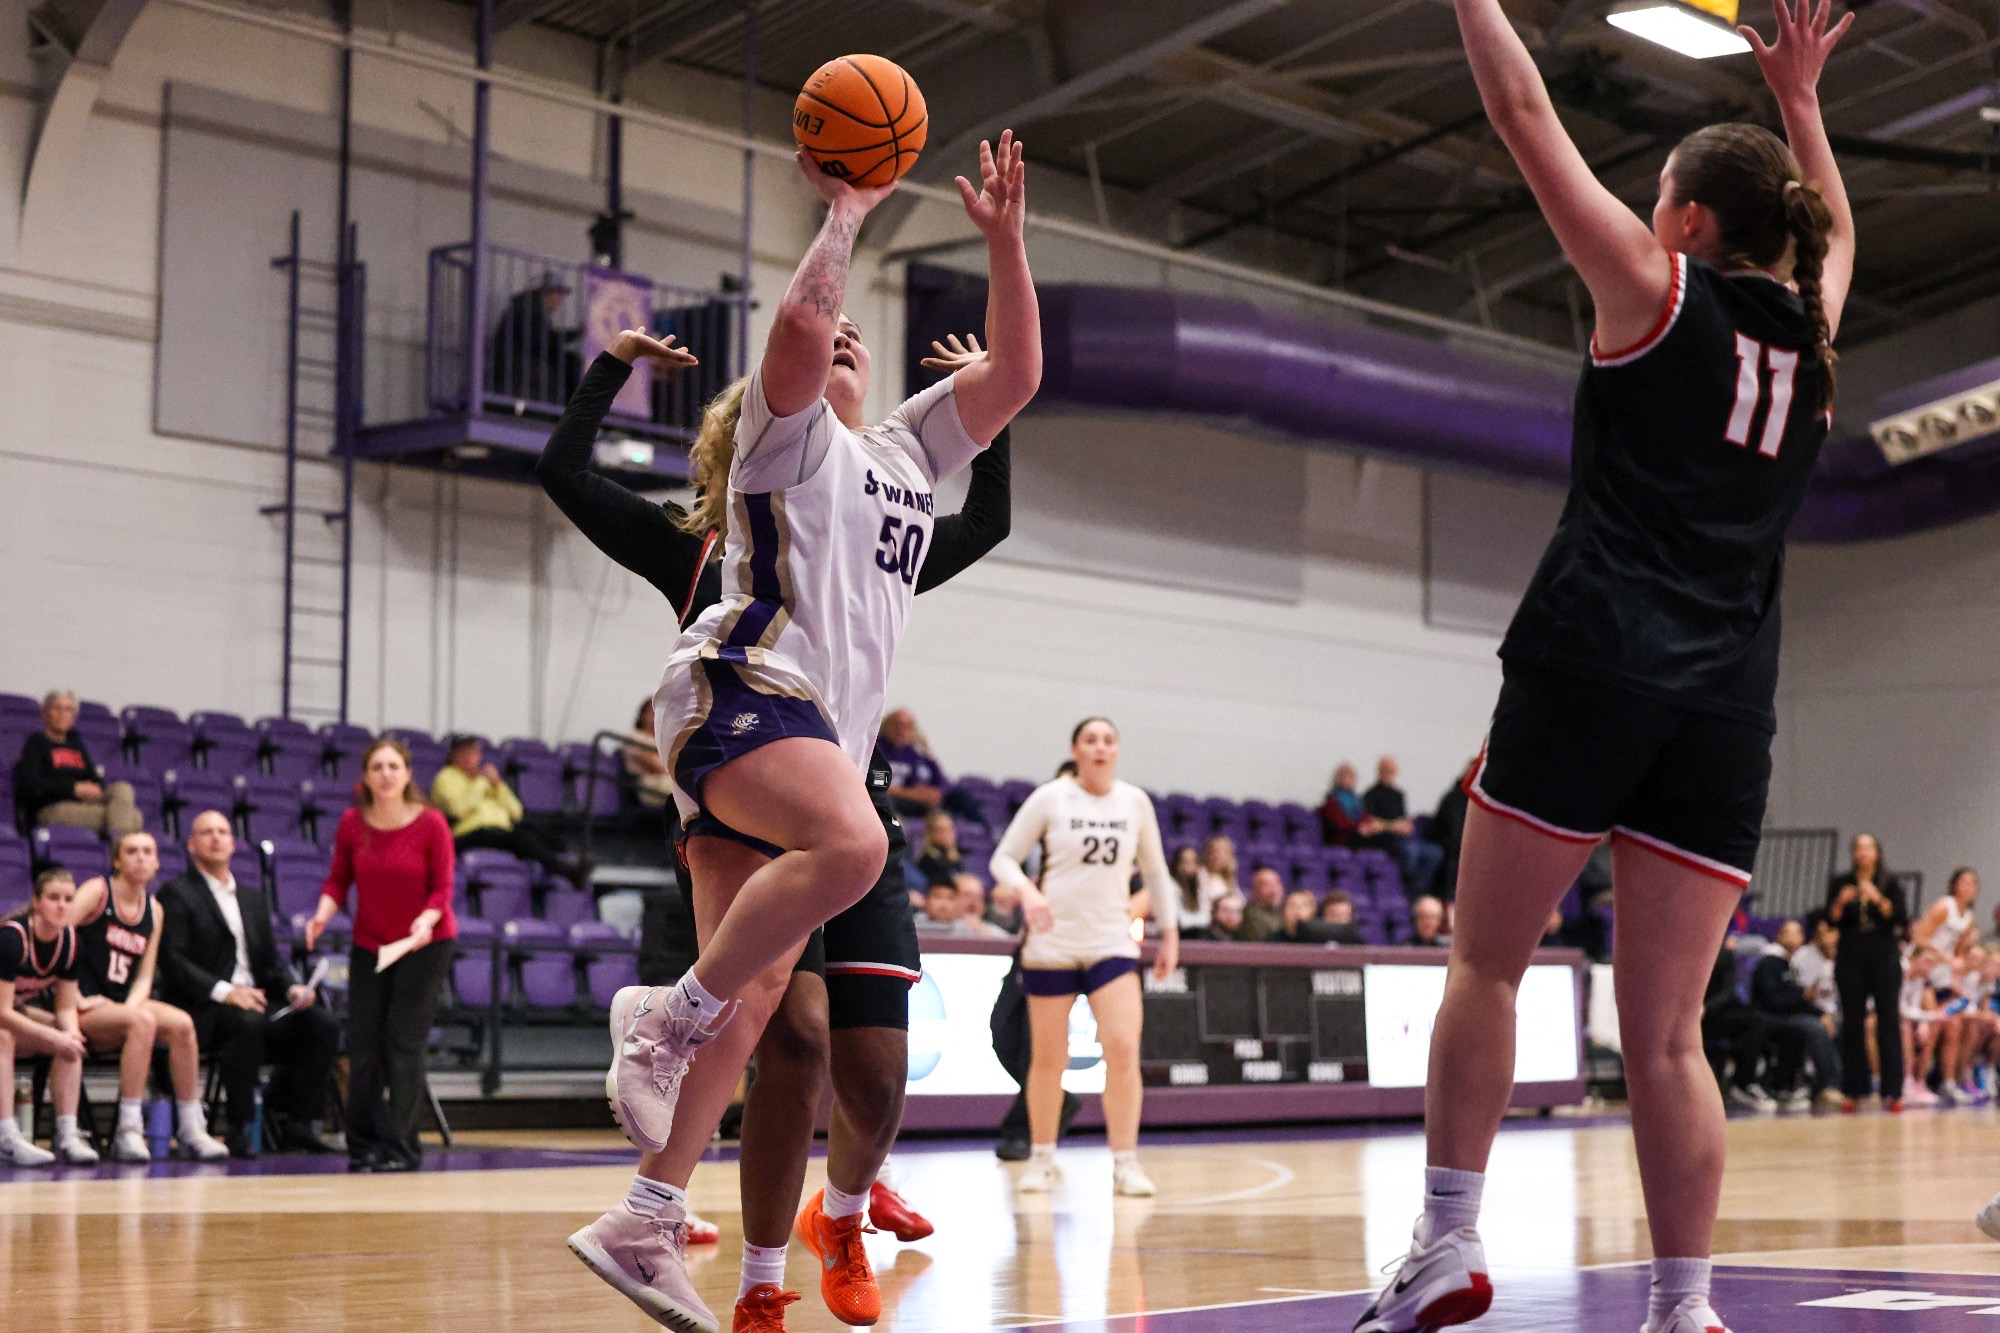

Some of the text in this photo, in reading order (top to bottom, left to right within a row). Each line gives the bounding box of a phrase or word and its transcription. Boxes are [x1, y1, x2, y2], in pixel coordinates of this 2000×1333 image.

[1724, 329, 1800, 459] 11
[876, 515, 924, 585] 50
[1082, 836, 1119, 865] 23
[107, 949, 133, 985] 15
